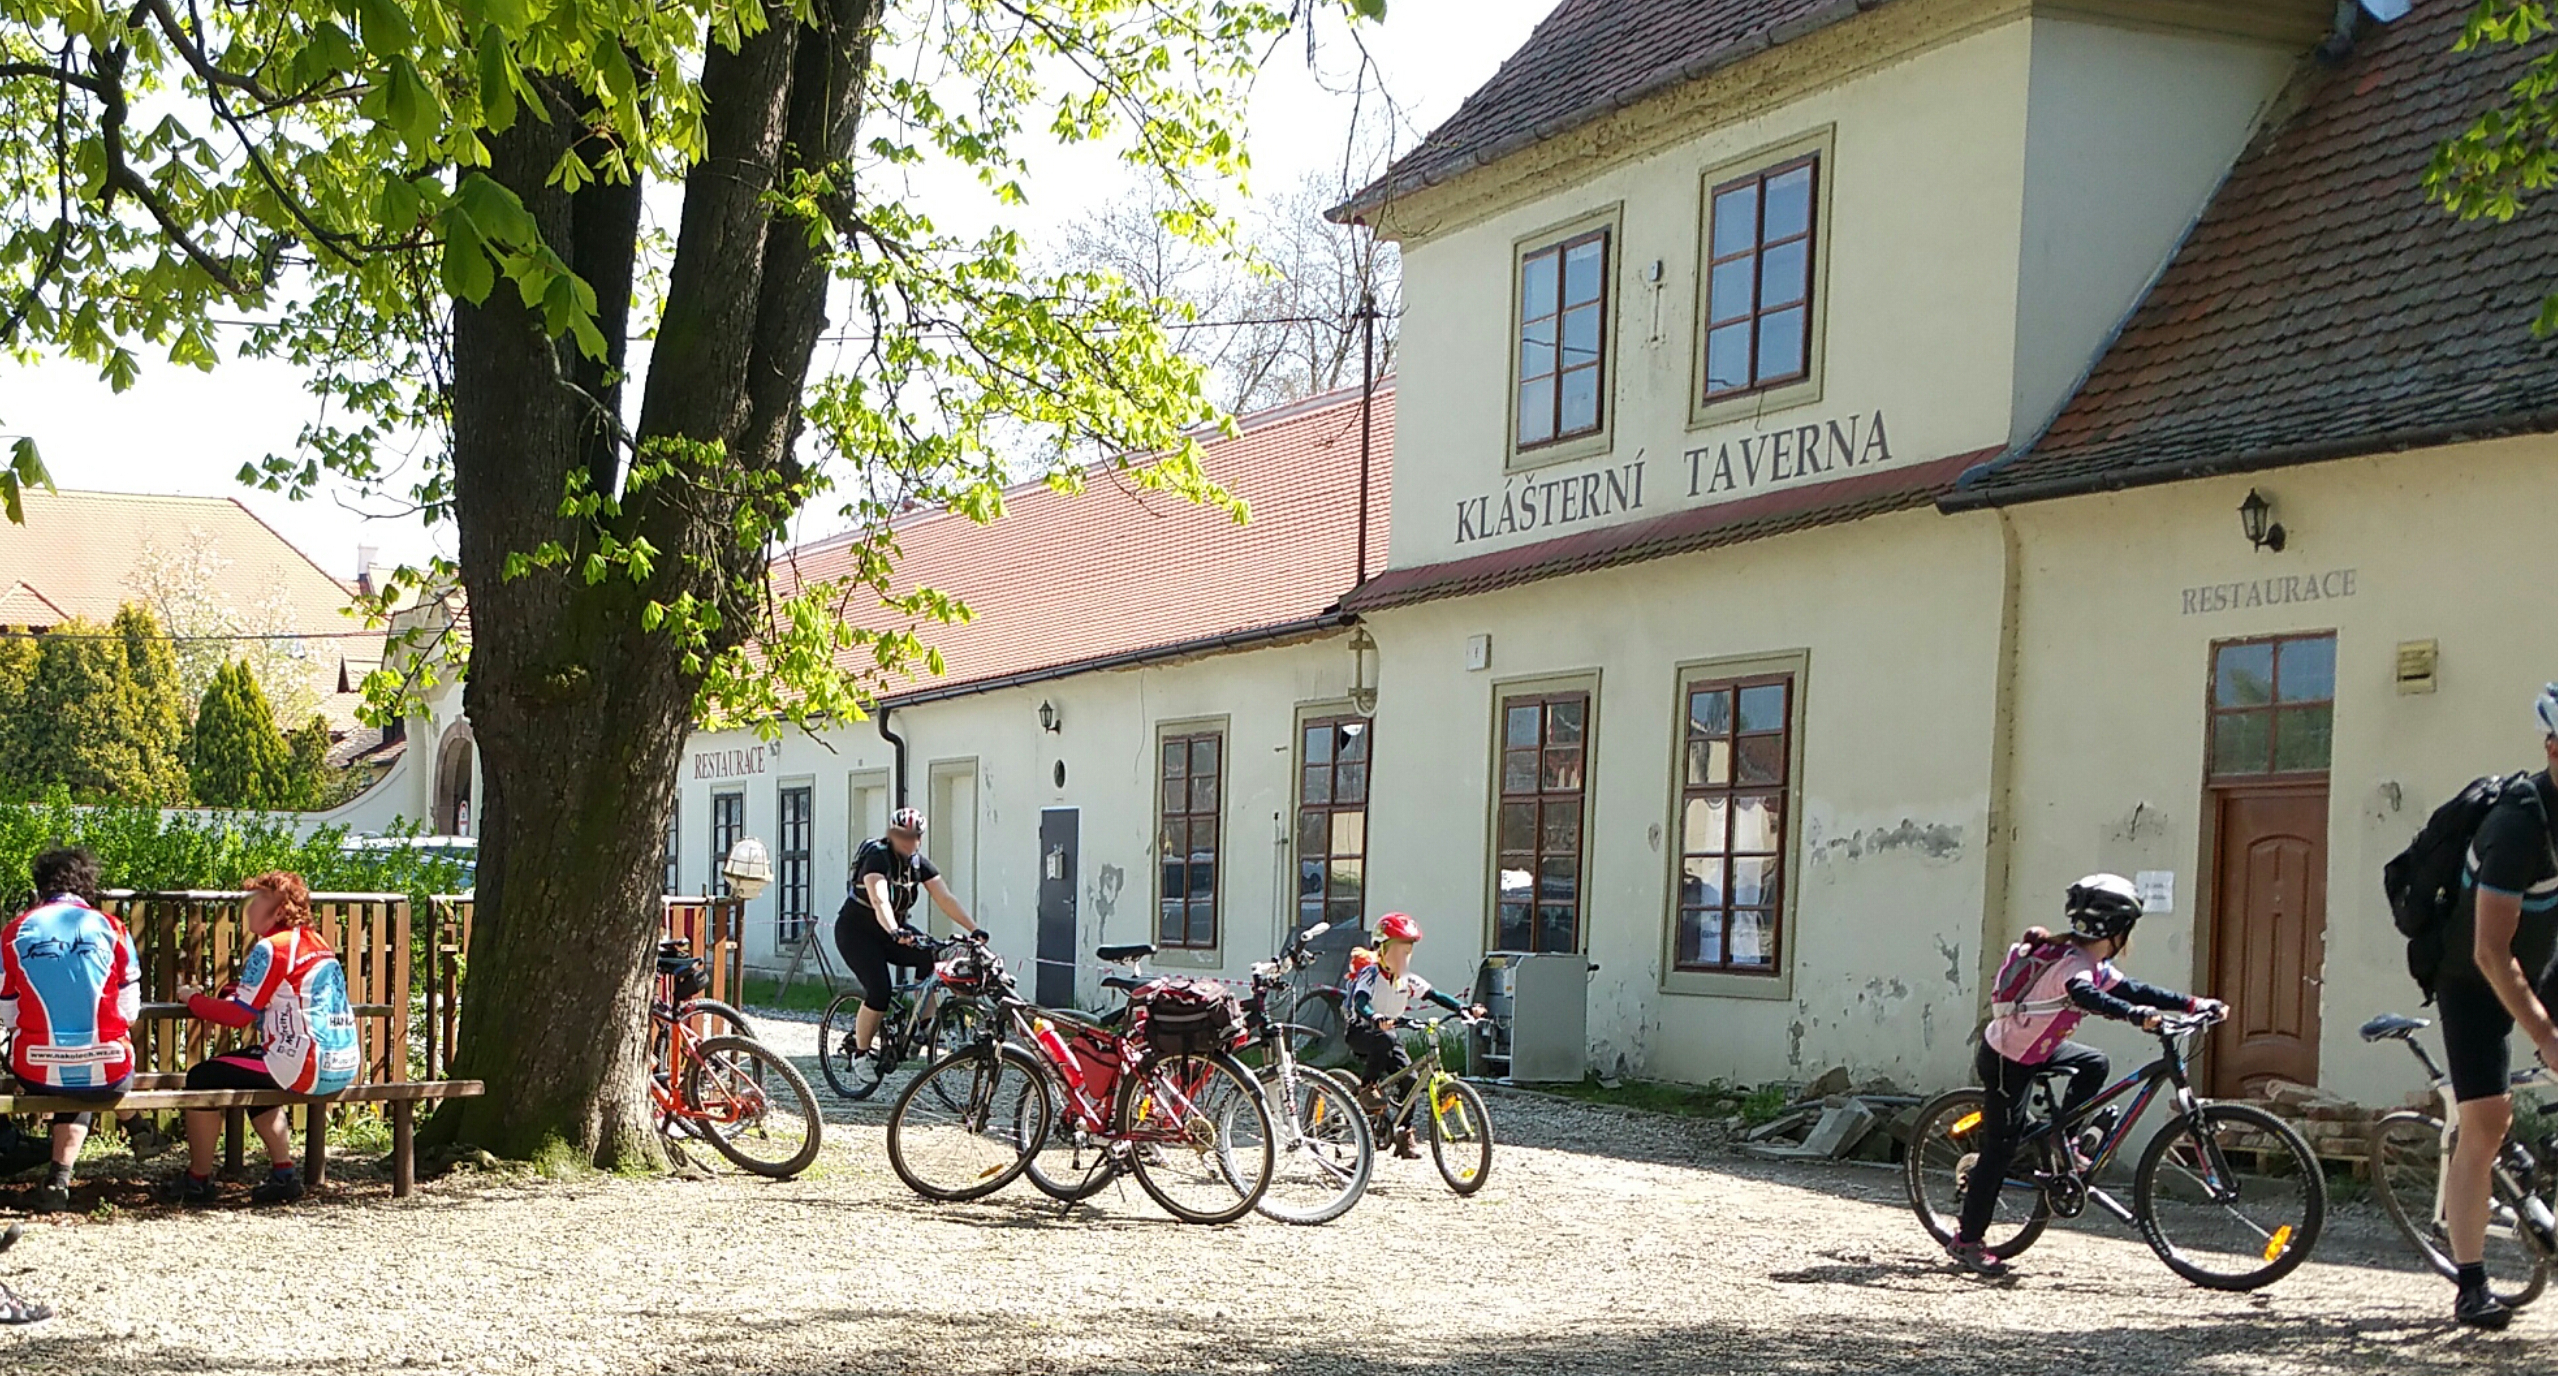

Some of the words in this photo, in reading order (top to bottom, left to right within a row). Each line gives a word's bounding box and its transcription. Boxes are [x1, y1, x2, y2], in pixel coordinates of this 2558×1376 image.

[1454, 447, 1646, 544] KLÁŠTERNÍ
[1683, 409, 1893, 498] TAVERNA
[2181, 568, 2358, 615] RESTAURACE
[693, 745, 766, 780] RESTAURACE
